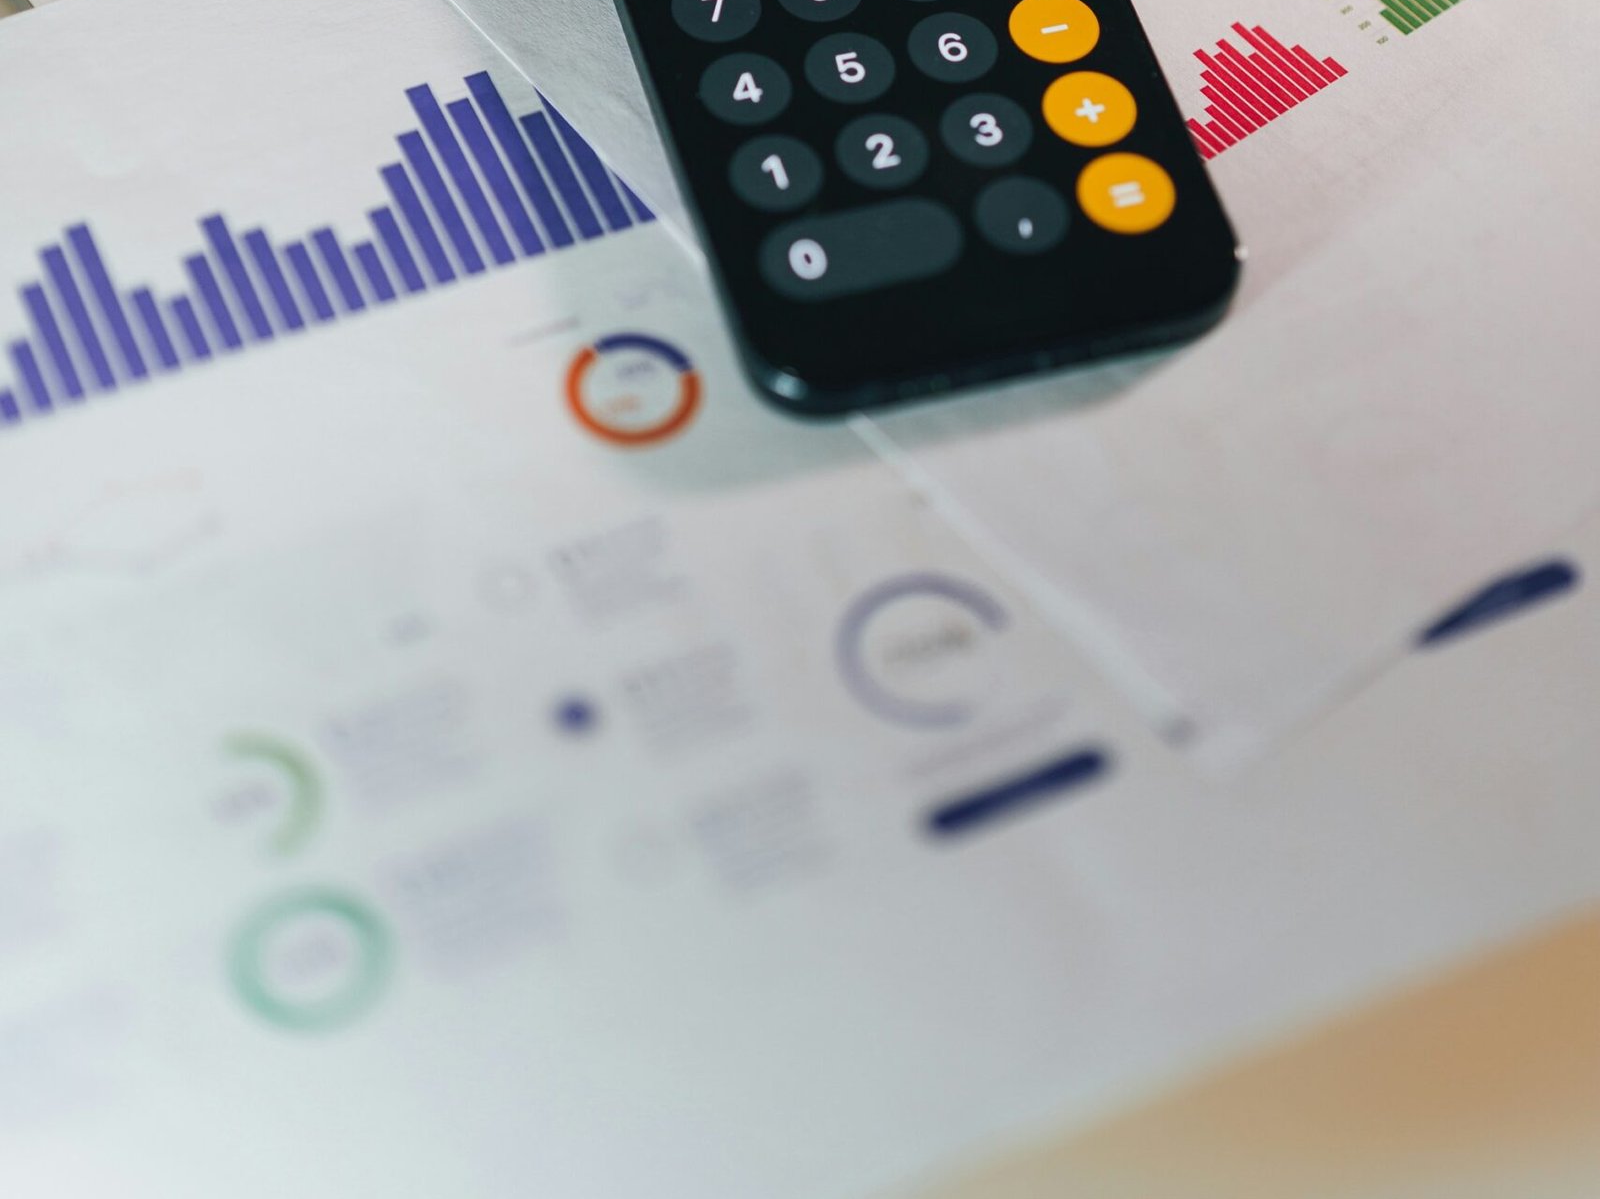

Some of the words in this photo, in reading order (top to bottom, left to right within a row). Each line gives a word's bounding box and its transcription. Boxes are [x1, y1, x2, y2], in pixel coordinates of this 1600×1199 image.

[732, 71, 764, 104] 4
[834, 51, 866, 84] 5
[937, 32, 968, 63] 6
[760, 153, 790, 191] 1
[864, 133, 902, 171] 2
[969, 112, 1004, 148] 3
[787, 238, 828, 281] 0
